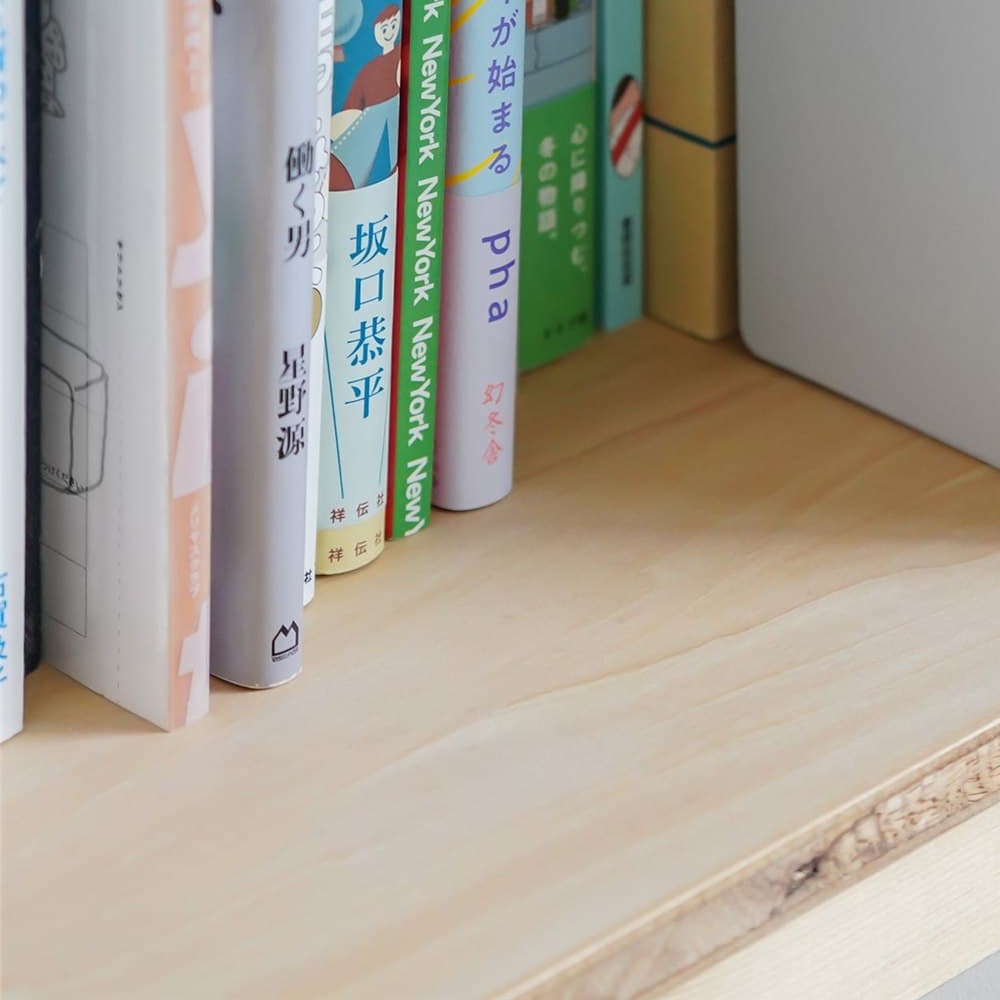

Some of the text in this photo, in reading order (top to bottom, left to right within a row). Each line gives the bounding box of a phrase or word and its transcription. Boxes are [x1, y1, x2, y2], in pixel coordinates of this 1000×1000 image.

[418, 33, 443, 165] NewYork
[282, 138, 314, 263] 働く男
[413, 176, 439, 306] NewYork
[344, 214, 390, 419] 坂口恭平
[481, 229, 517, 323] pha
[277, 343, 308, 460] 星野源
[407, 315, 433, 447] NewYork
[328, 531, 382, 563] 祥伝社
[329, 491, 385, 524] 祥伝社
